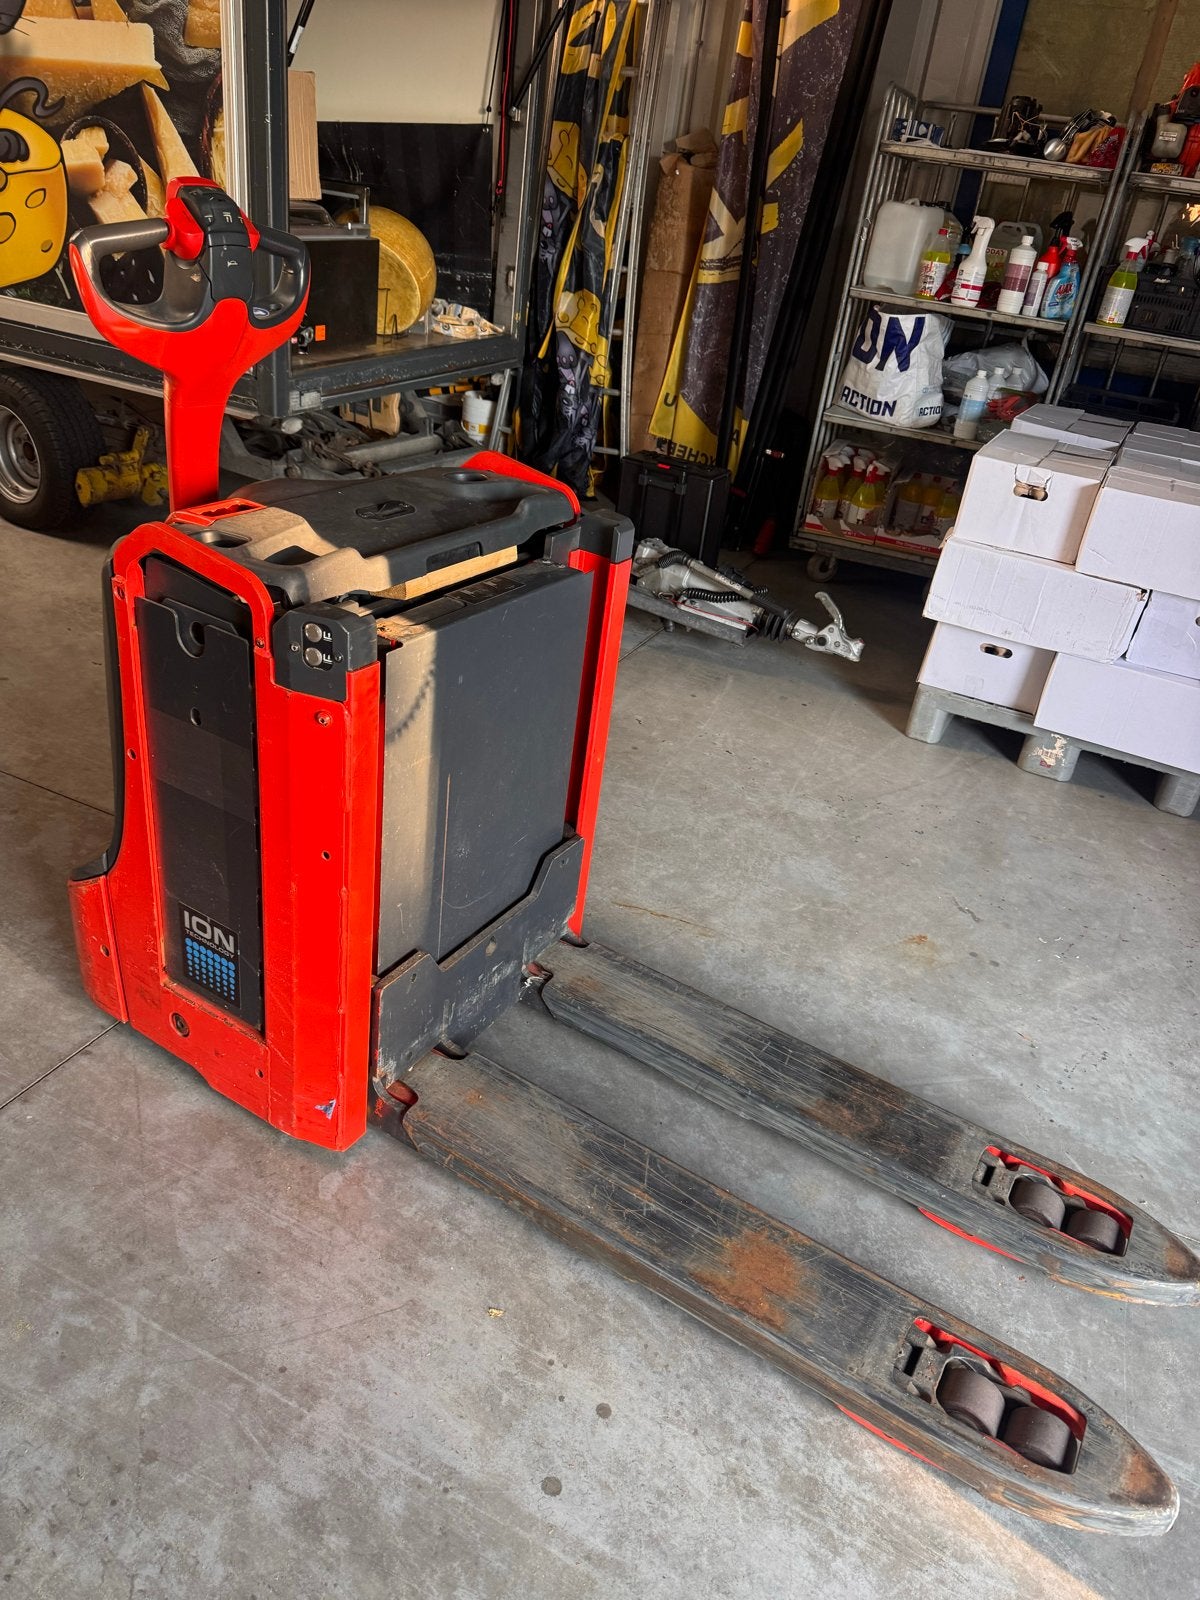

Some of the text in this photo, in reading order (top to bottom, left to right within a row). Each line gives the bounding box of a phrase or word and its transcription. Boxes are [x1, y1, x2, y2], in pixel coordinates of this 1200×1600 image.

[840, 385, 898, 417] ACTION
[183, 909, 235, 954] ION
[185, 928, 235, 959] TECHNOLOGY
